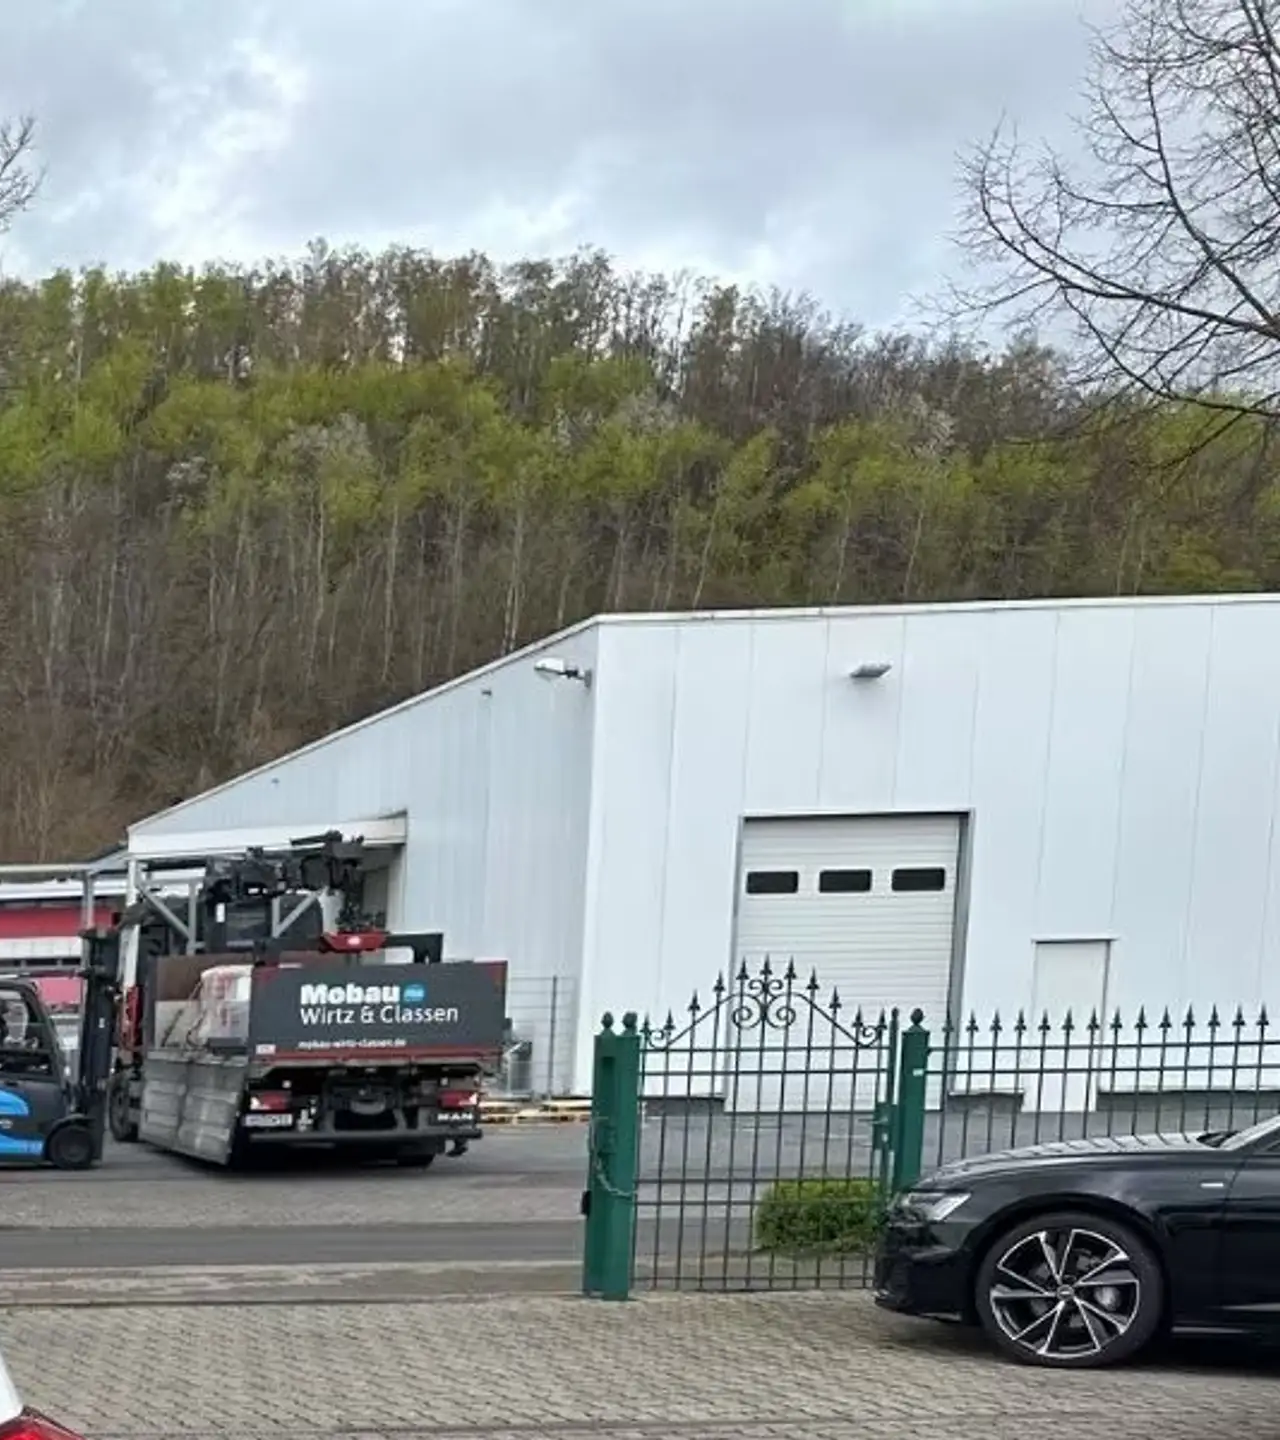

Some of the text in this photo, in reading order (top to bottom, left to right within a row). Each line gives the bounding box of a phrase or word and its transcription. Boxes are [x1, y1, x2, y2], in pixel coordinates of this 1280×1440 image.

[300, 983, 401, 1005] Mobau
[300, 1004, 459, 1026] Wirtz & Classen
